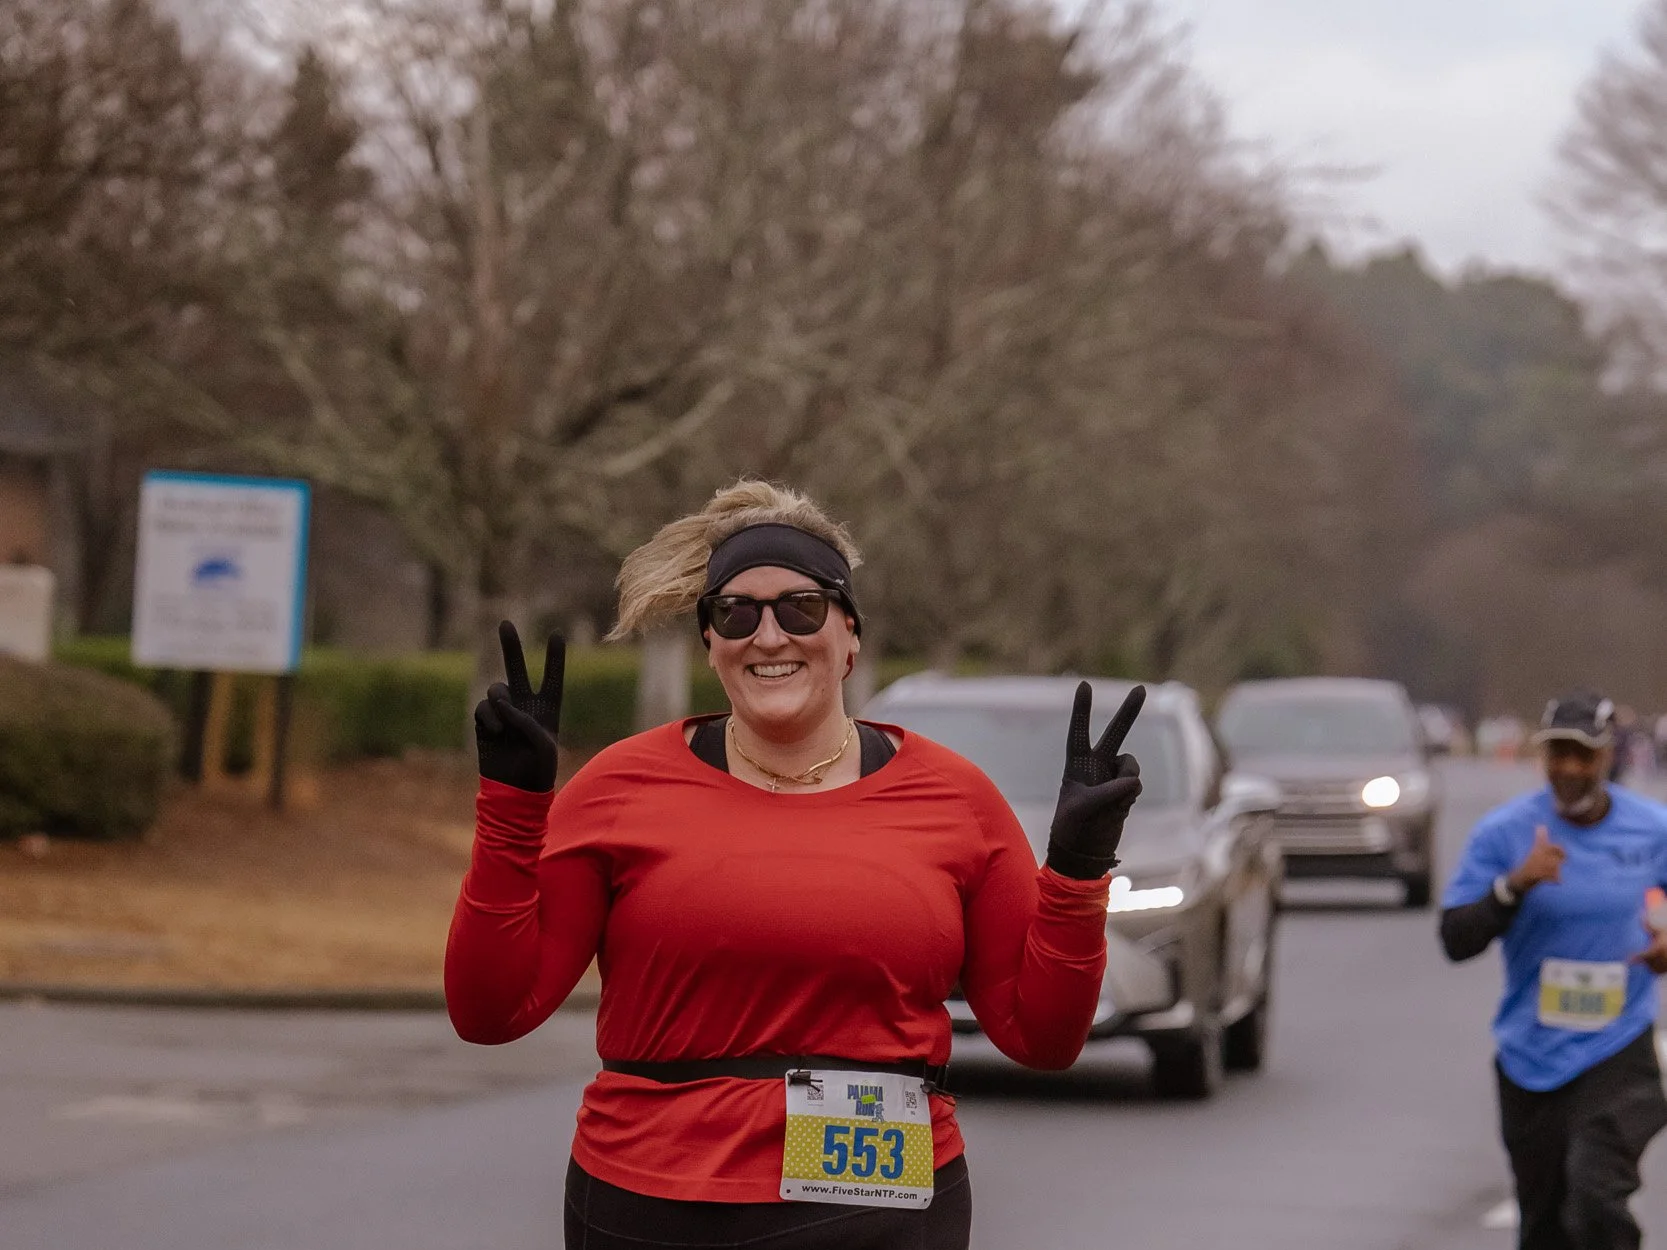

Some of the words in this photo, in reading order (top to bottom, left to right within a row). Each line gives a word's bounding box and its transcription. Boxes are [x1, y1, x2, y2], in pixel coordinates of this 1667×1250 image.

[847, 1084, 883, 1102] PAJAMA
[856, 1100, 876, 1116] RUN
[822, 1125, 905, 1180] 553
[801, 1185, 918, 1200] www.FiveStarNTP.com
